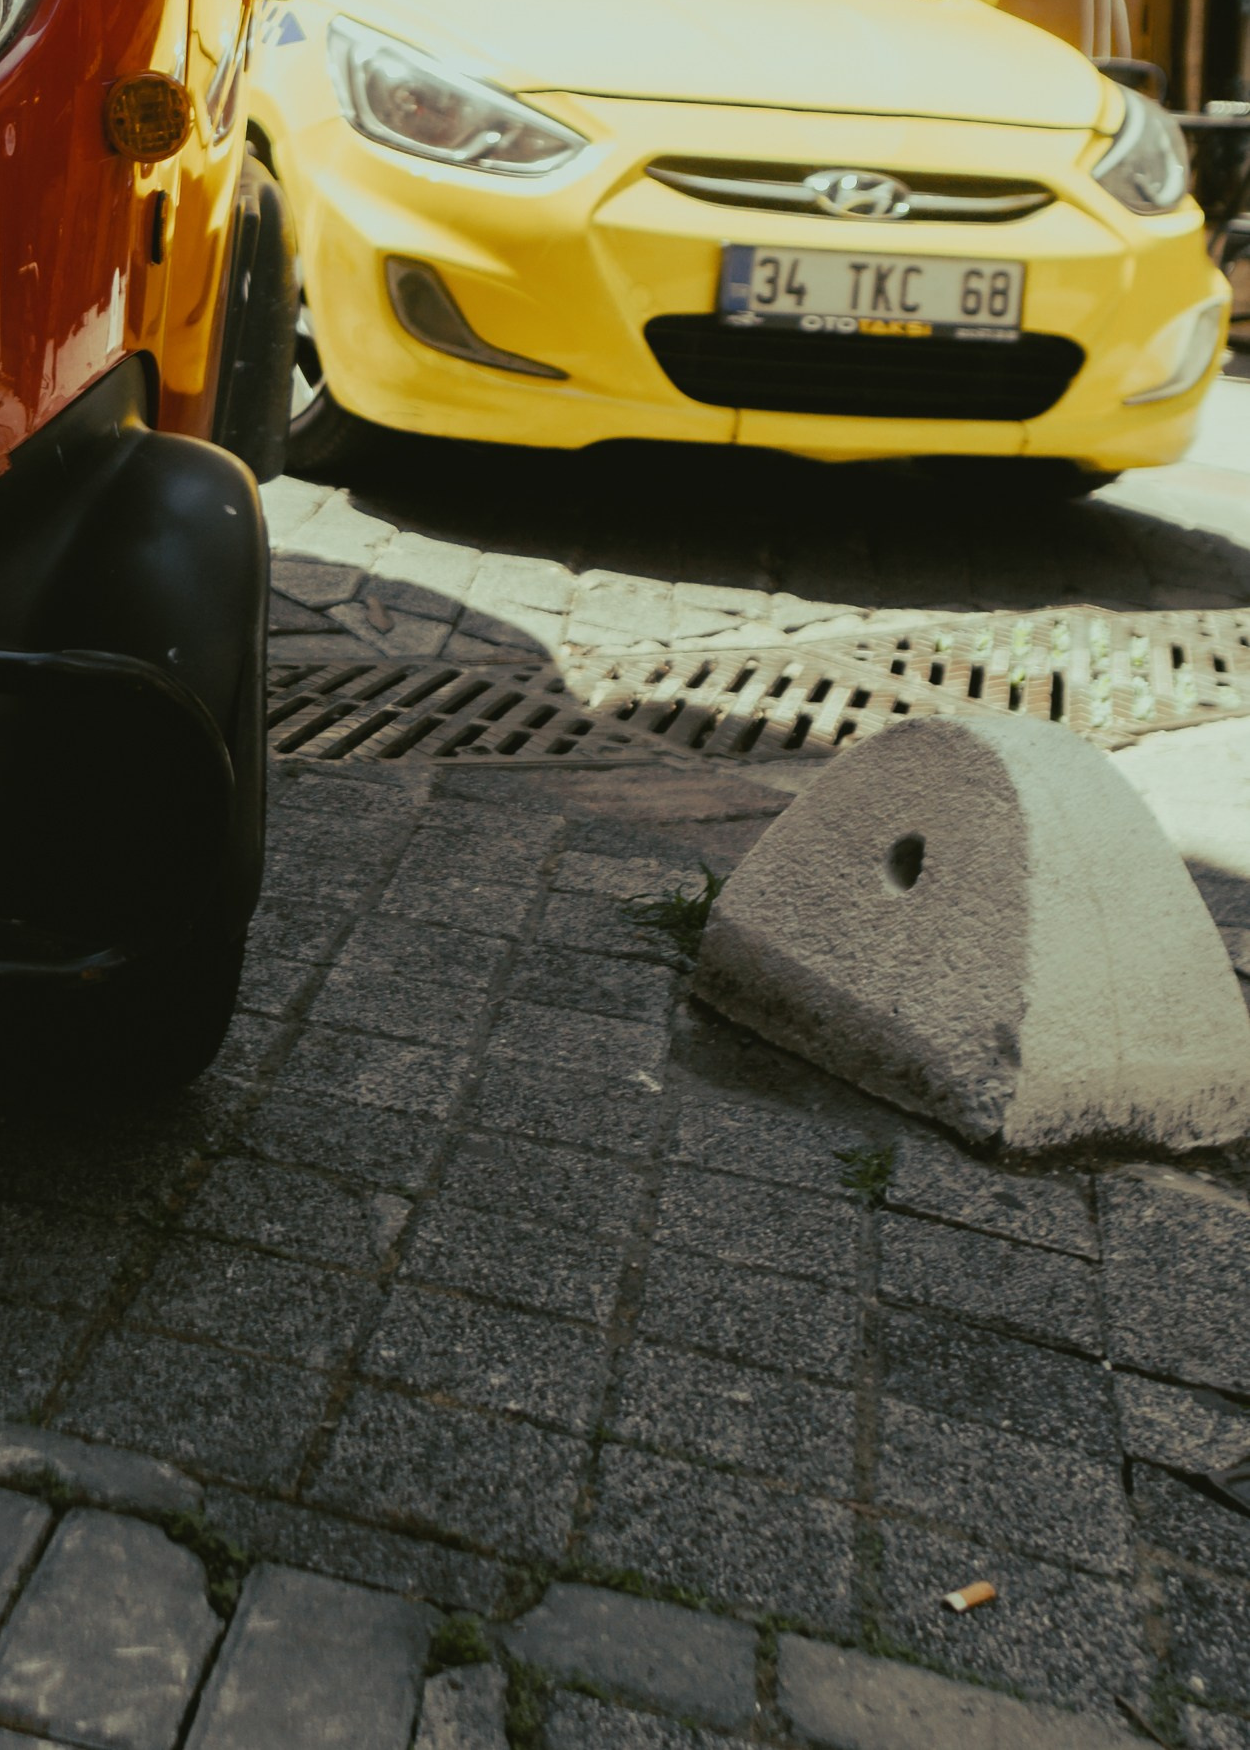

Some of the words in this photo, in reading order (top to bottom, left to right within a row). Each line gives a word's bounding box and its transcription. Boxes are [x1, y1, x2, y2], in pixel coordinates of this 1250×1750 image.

[756, 258, 806, 306] 34
[849, 262, 923, 312] TKC
[961, 269, 1012, 317] 68
